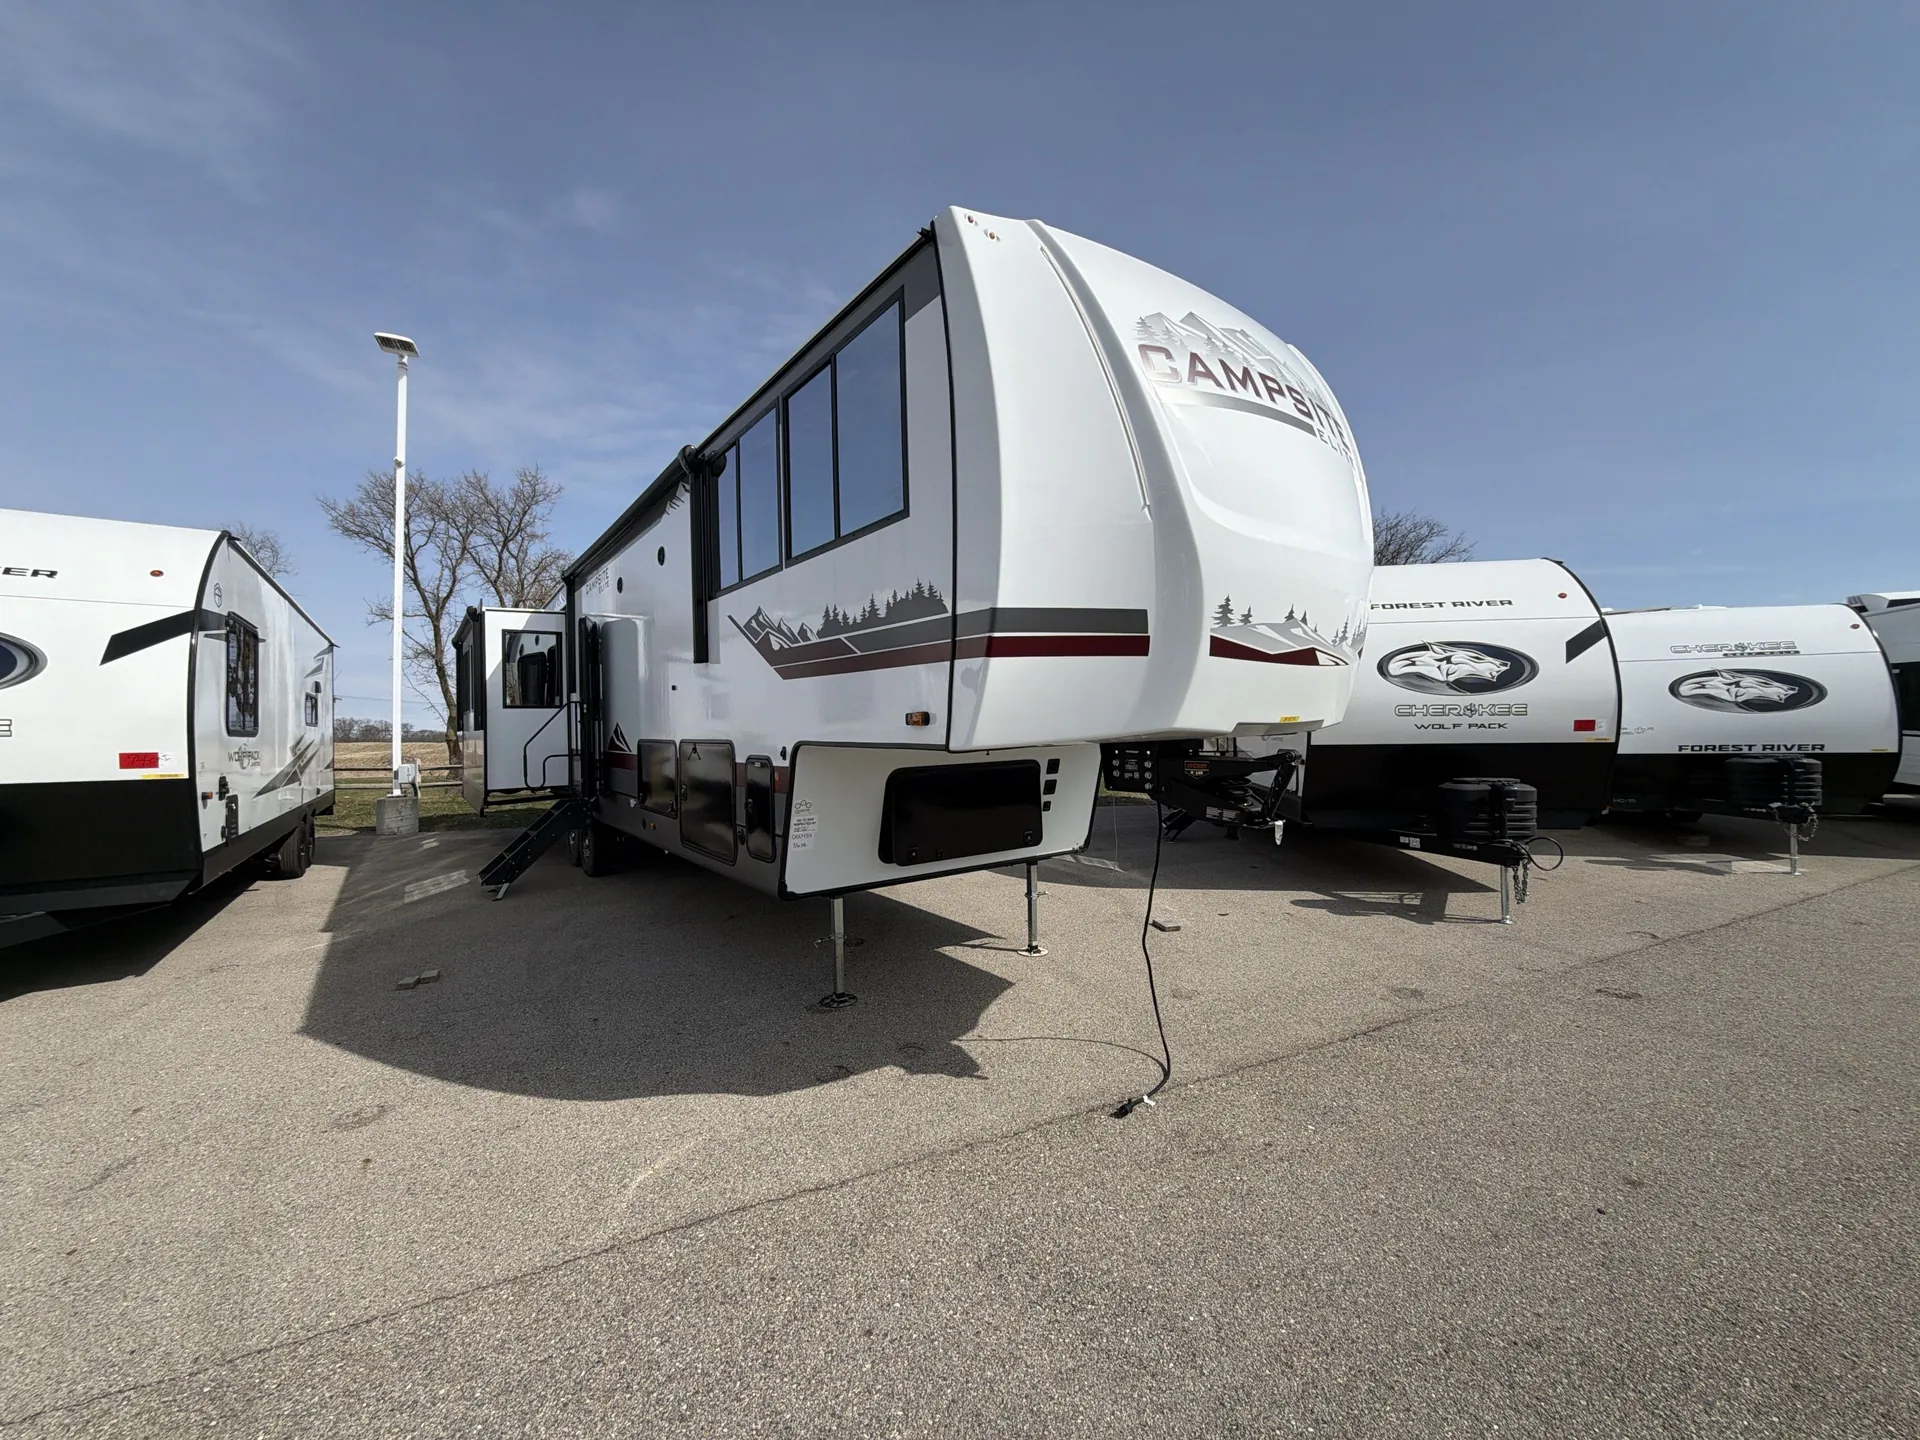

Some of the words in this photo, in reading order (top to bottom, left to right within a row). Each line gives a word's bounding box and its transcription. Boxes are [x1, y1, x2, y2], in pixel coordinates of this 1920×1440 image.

[1137, 343, 1352, 454] CAMPSITE
[0, 566, 59, 580] ER
[1370, 601, 1447, 610] FOREST
[1450, 599, 1514, 608] RIVER
[1669, 641, 1798, 655] CHEROKEE
[1394, 703, 1528, 718] CHEROKEE
[1467, 722, 1509, 730] PACK
[1677, 744, 1757, 752] FOREST
[1761, 743, 1826, 752] RIVER
